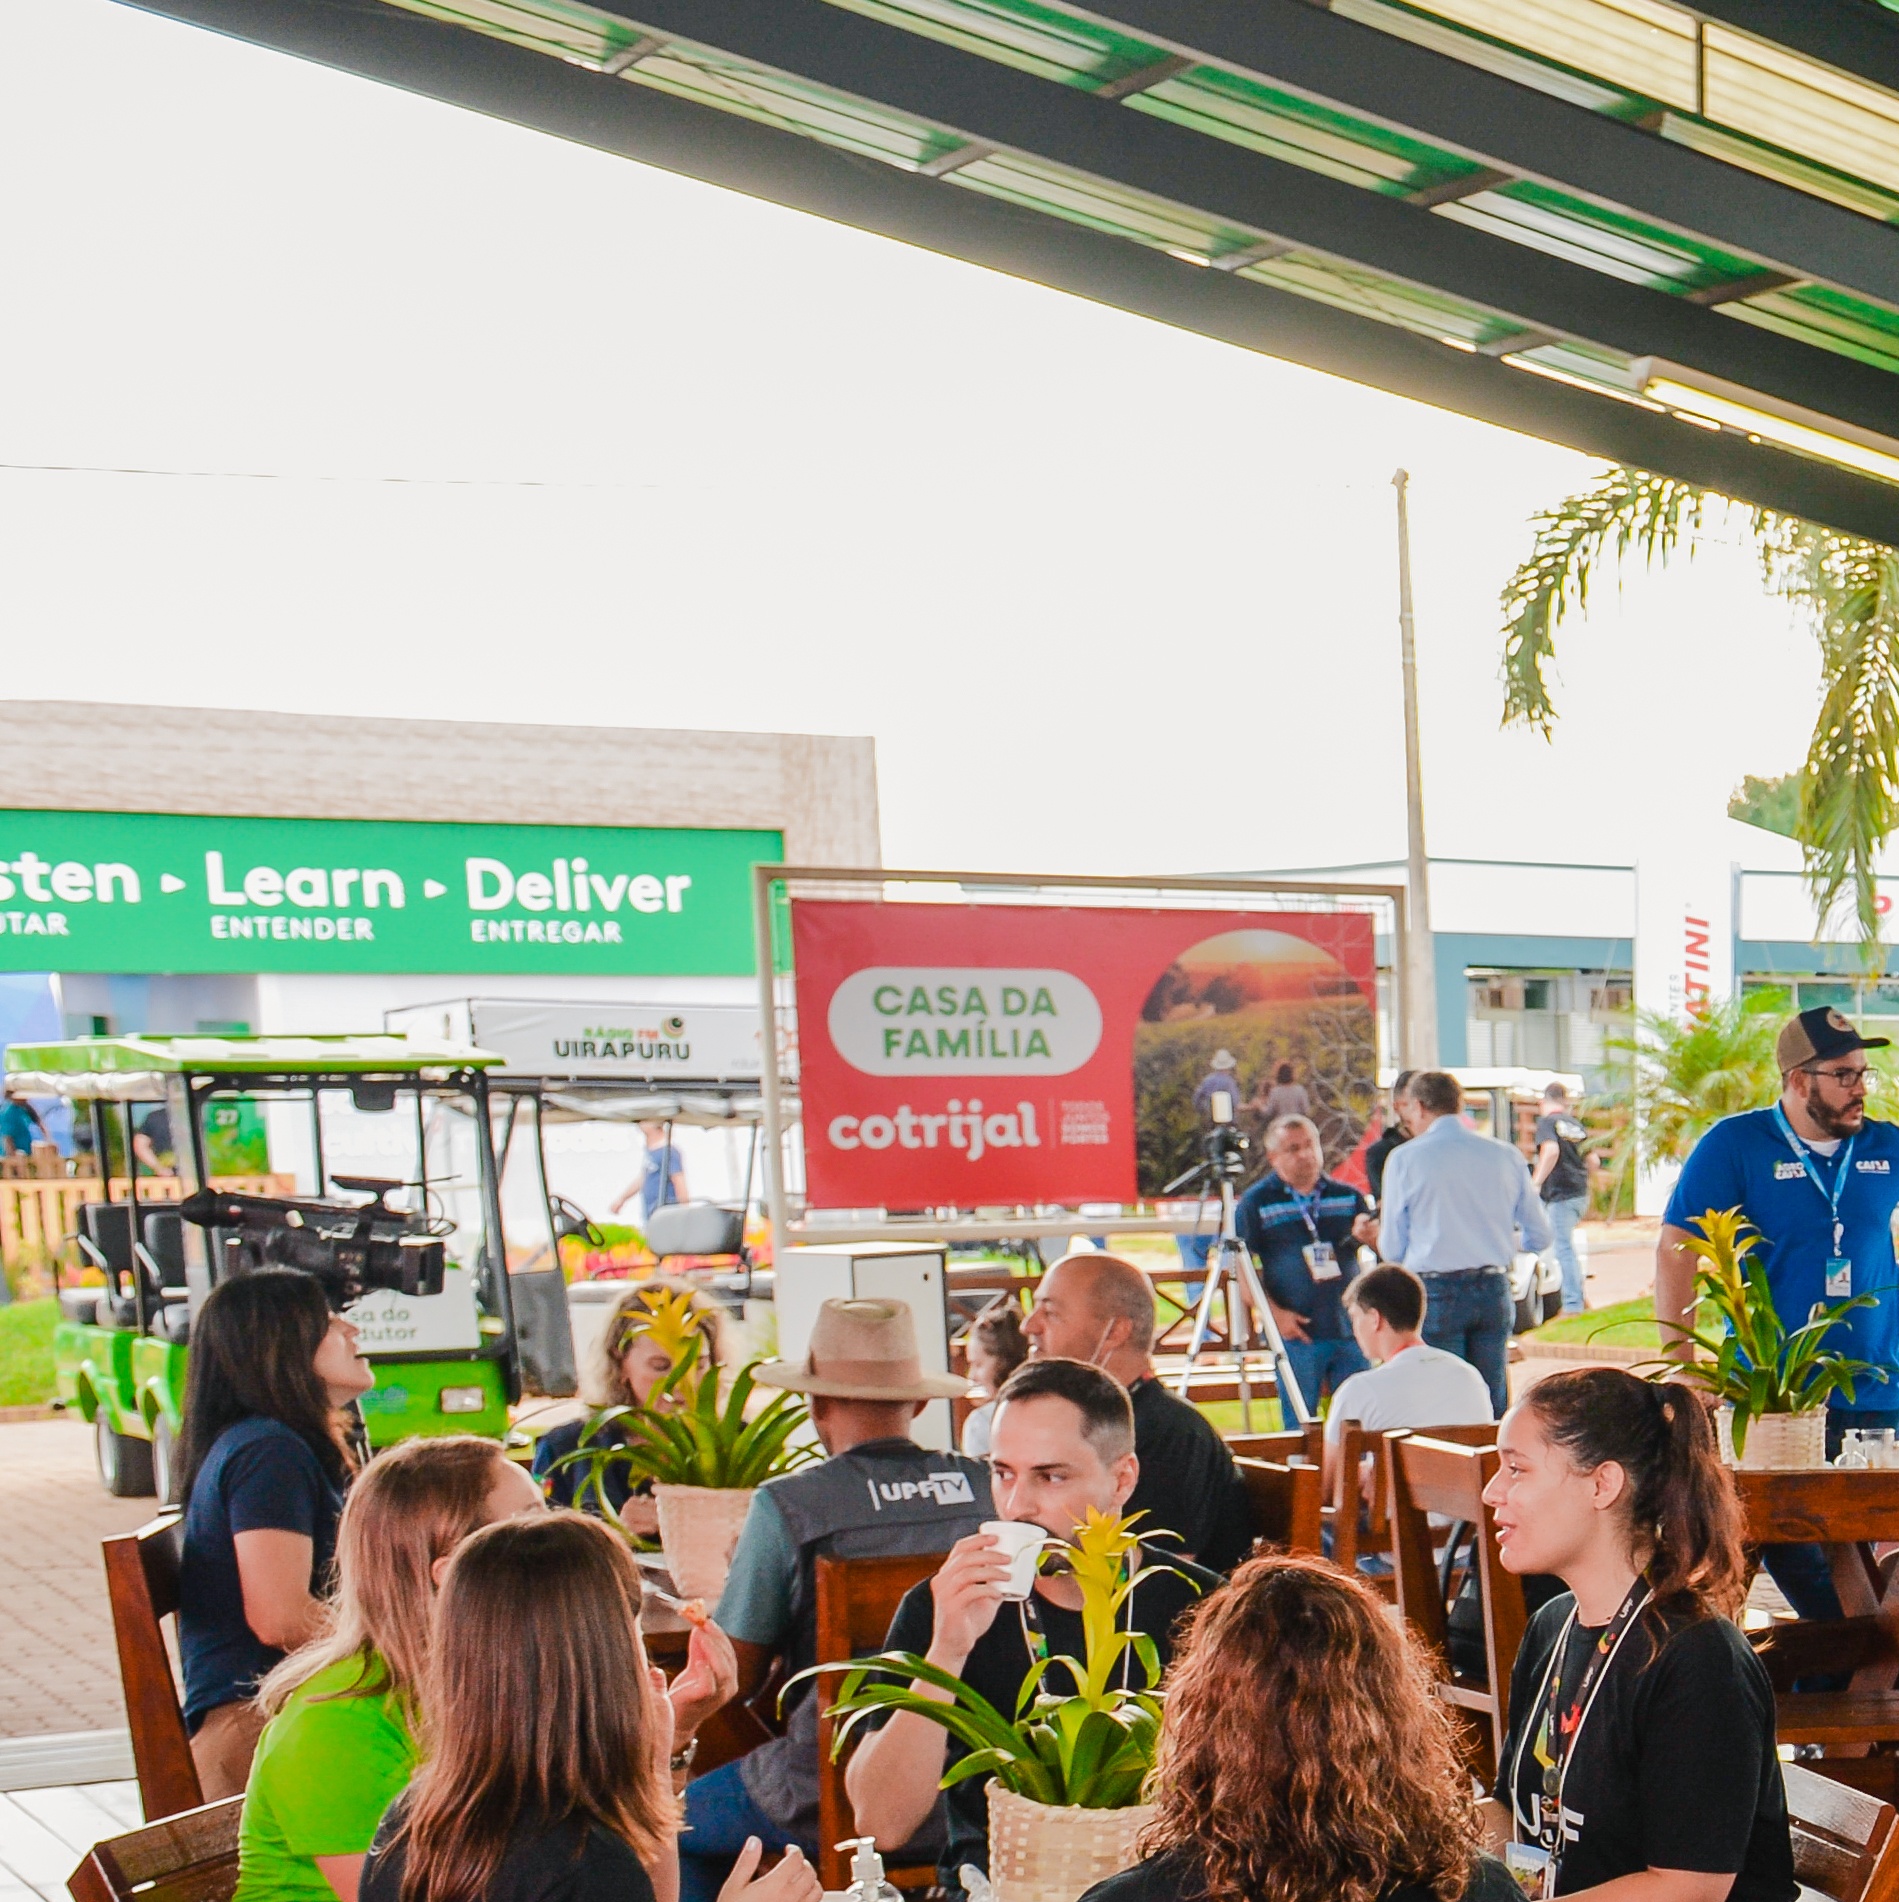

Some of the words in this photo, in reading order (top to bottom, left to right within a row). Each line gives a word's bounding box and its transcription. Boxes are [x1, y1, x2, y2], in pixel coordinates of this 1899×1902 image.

[205, 851, 405, 908] Learn
[466, 857, 692, 914] Deliver
[211, 915, 374, 941] ENTENDER
[470, 919, 623, 943] ENTREGAR
[872, 985, 989, 1017] CASA
[1002, 986, 1058, 1017] DA
[554, 1040, 690, 1060] UIRAPURU
[884, 1019, 1051, 1059] FAMÍLIA
[828, 1098, 1041, 1162] cotrijal
[1856, 1160, 1891, 1171] CAIXA
[382, 1307, 410, 1322] do
[1515, 1792, 1585, 1842] UF
